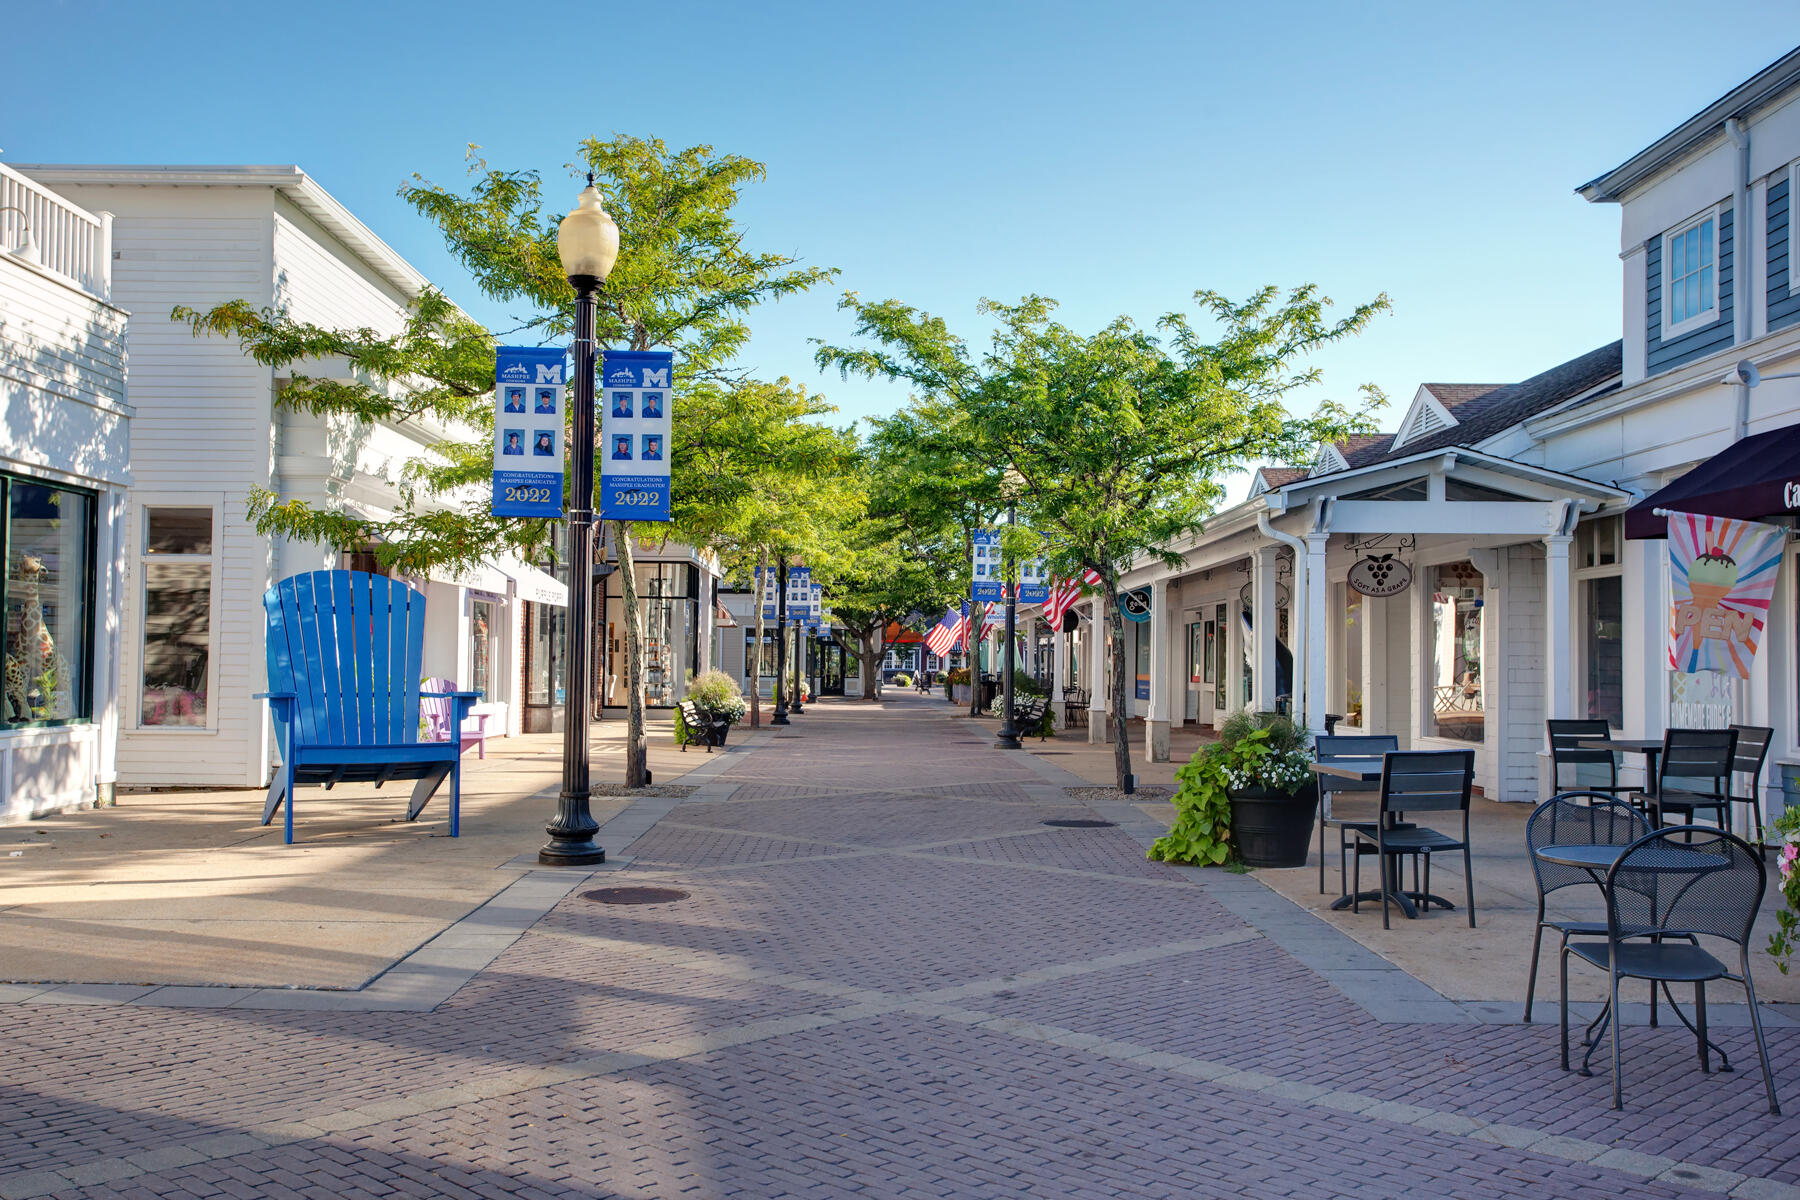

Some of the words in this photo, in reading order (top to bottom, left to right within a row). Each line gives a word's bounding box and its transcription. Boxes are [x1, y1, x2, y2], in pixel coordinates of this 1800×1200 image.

[505, 487, 550, 503] 2022
[615, 491, 659, 506] 2022
[977, 588, 997, 596] 2022
[1353, 578, 1370, 590] SOFT
[1387, 577, 1407, 592] GRAPE
[1025, 590, 1044, 598] 2022
[1706, 703, 1726, 730] FUDGE
